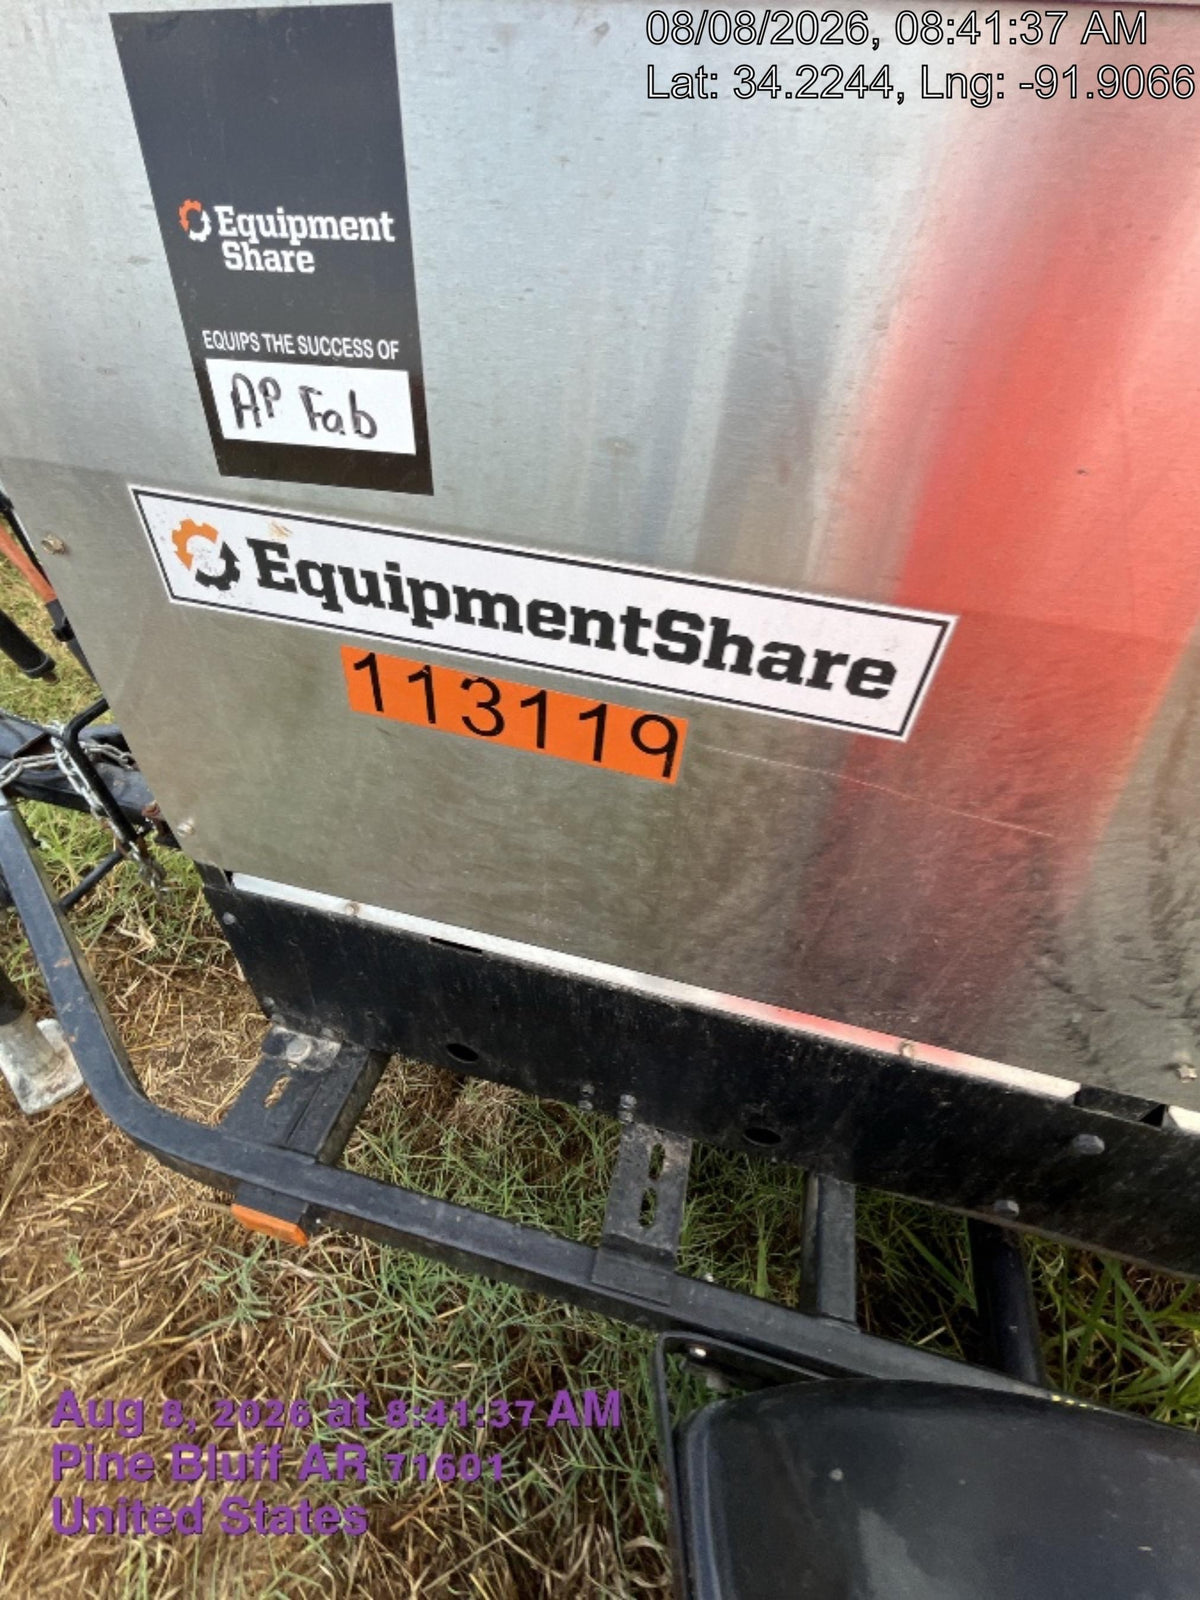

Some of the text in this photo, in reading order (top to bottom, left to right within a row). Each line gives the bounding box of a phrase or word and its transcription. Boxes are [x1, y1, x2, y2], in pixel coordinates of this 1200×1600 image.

[214, 204, 396, 244] Equipment
[222, 241, 316, 274] Share
[202, 329, 400, 361] EQUIPS THE SUCCESS OF
[231, 372, 378, 440] AP Fab
[246, 536, 897, 700] EquipmentShare
[352, 652, 682, 779] 113119
